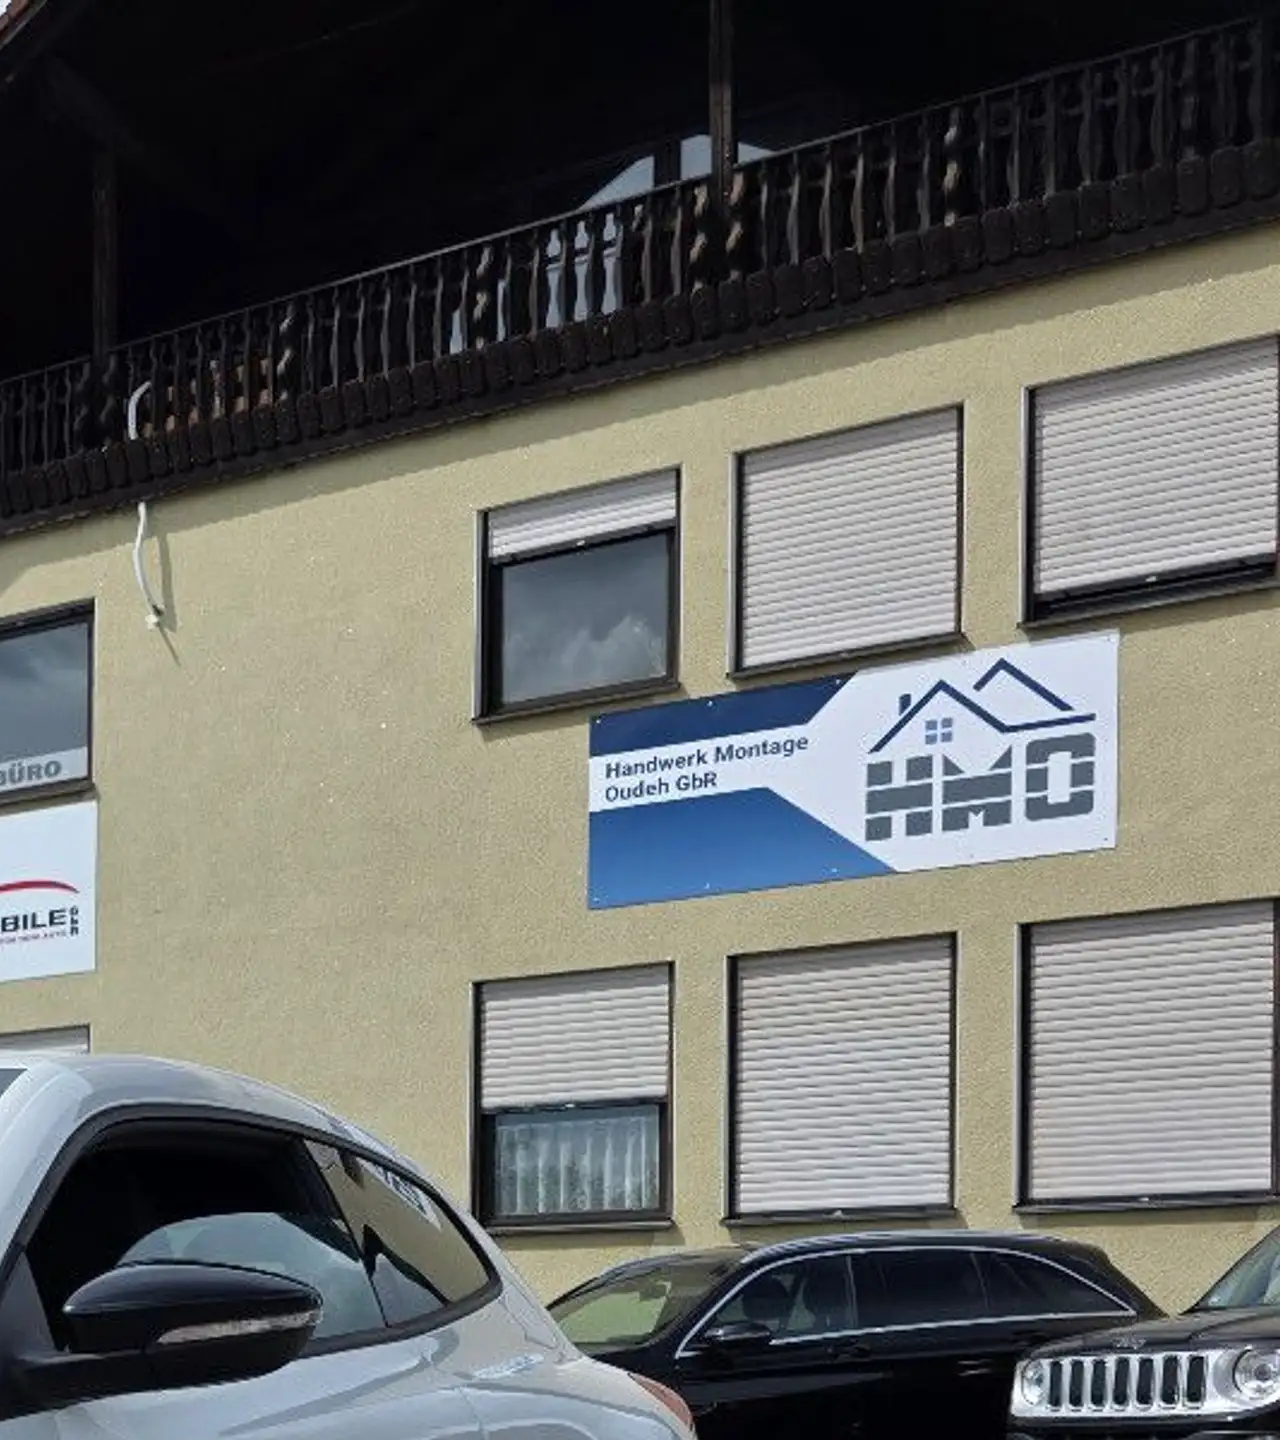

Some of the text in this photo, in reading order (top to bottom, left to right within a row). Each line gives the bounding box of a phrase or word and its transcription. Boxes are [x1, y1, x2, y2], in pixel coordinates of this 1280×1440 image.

[605, 736, 809, 779] Handwerk Montage
[605, 772, 717, 802] Oudeh GbR
[865, 732, 1096, 841] HMO
